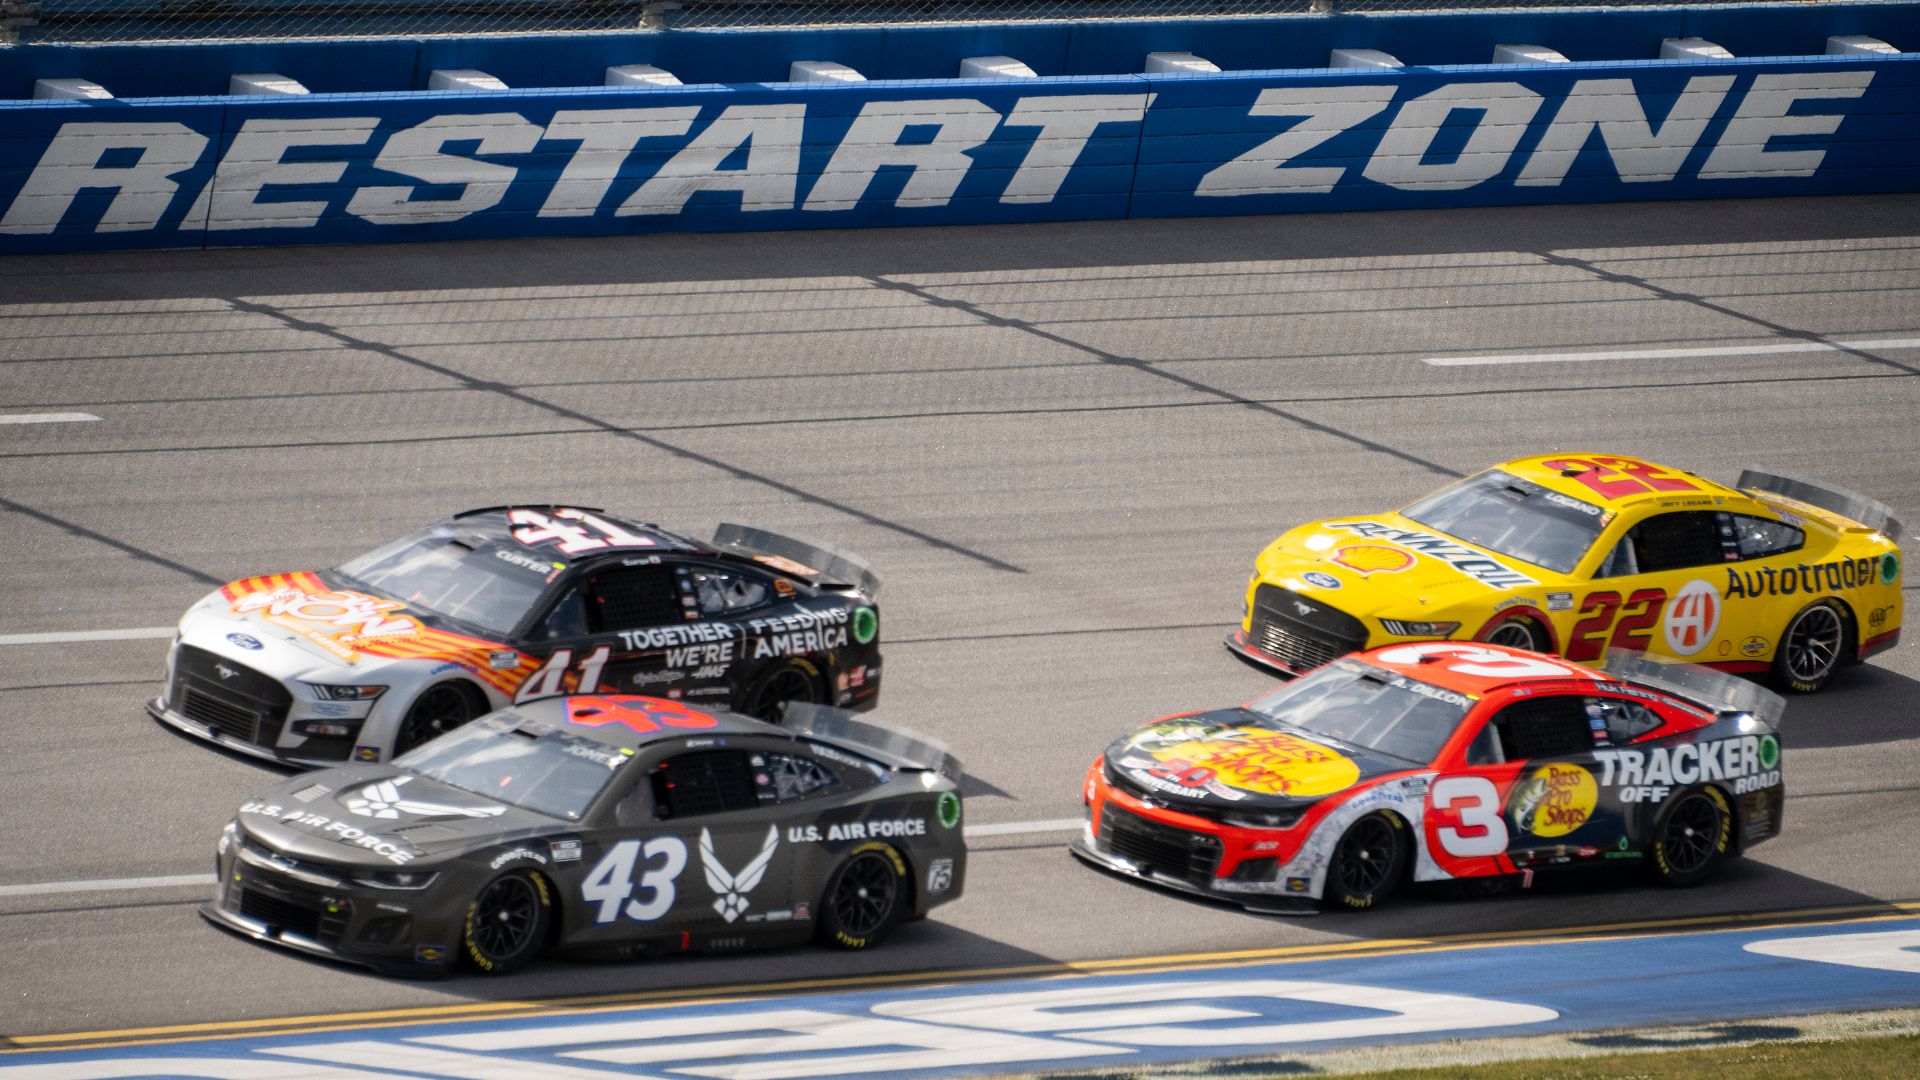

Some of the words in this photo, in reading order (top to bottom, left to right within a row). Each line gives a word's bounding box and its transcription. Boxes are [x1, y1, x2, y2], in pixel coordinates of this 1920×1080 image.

[1, 92, 1158, 235] RESTART
[1194, 71, 1877, 197] ZONE
[1542, 457, 1703, 500] 22
[1544, 492, 1600, 515] LOGANO
[508, 508, 657, 554] 41
[495, 549, 550, 575] CUSTER
[1324, 522, 1541, 590] PENNZOIL
[1725, 555, 1880, 600] Autotrader
[618, 622, 733, 651] TOGETHER
[750, 606, 848, 635] FEEDING
[1565, 588, 1667, 662] 22
[665, 642, 733, 669] WE'RE
[754, 627, 848, 660] AMERICA
[514, 647, 611, 706] 41
[1377, 644, 1574, 679] 3
[1390, 678, 1407, 689] A.
[1410, 682, 1471, 707] DILLON
[564, 694, 719, 735] 43
[1547, 767, 1582, 786] Bass
[1593, 734, 1759, 787] TRACKER
[1542, 784, 1573, 806] Pro
[1619, 786, 1671, 803] OFF
[1735, 770, 1780, 795] ROAD
[788, 825, 823, 843] U.S.
[828, 822, 867, 841] AIR
[867, 818, 926, 838] FORCE
[1432, 775, 1509, 858] 3
[1543, 806, 1588, 830] Shops
[240, 802, 283, 817] U.S.
[281, 811, 330, 828] AIR
[324, 821, 415, 865] FORCE
[490, 847, 547, 870] GOODYEAR
[580, 836, 688, 926] 43
